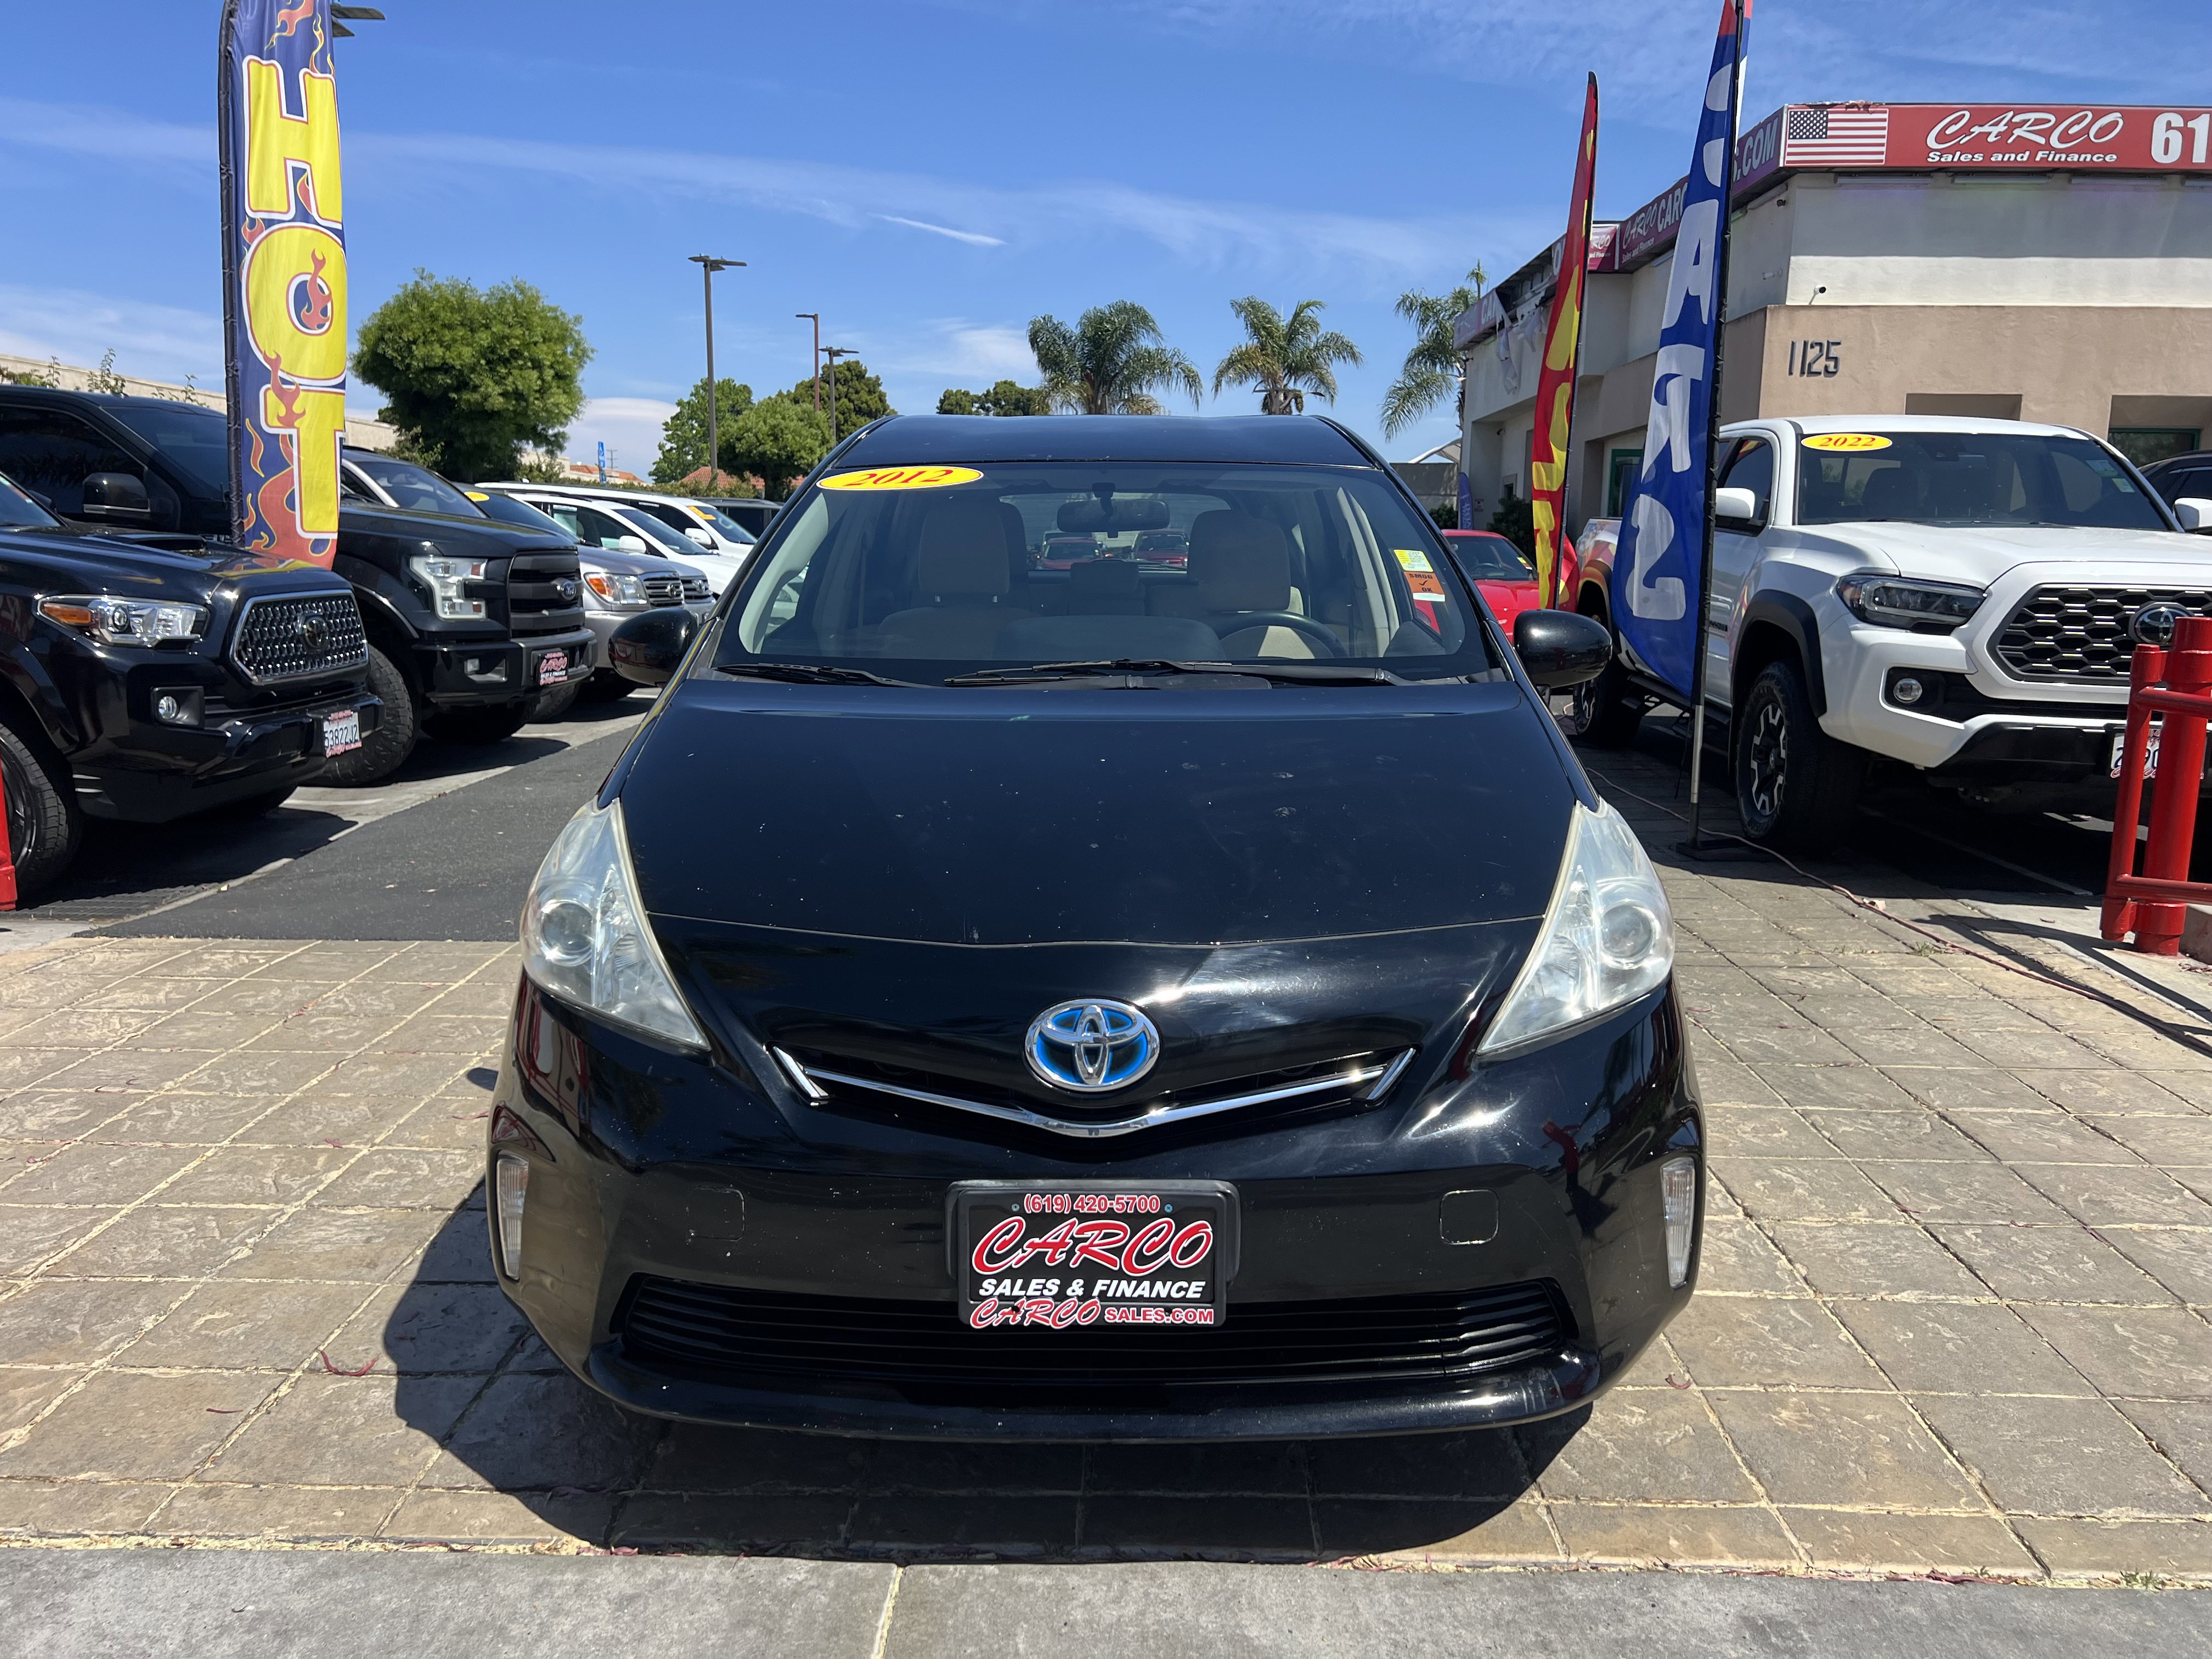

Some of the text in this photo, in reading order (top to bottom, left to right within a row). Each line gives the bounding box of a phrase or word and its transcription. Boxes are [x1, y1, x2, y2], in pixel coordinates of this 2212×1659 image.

[1926, 110, 2124, 149] CARCO
[1927, 150, 2118, 162] Sales and Finance
[1590, 235, 1611, 250] RCO
[241, 55, 347, 540] HOT
[1788, 340, 1842, 378] 1125
[1819, 437, 1876, 447] 2022
[842, 470, 953, 487] 2012
[325, 724, 358, 748] 53822J2
[1023, 1194, 1161, 1214] (619) 420-5700
[972, 1216, 1214, 1276] CARCO
[979, 1278, 1206, 1299] SALES & FINANCE
[969, 1297, 1214, 1329] CARCO SALES.COM
